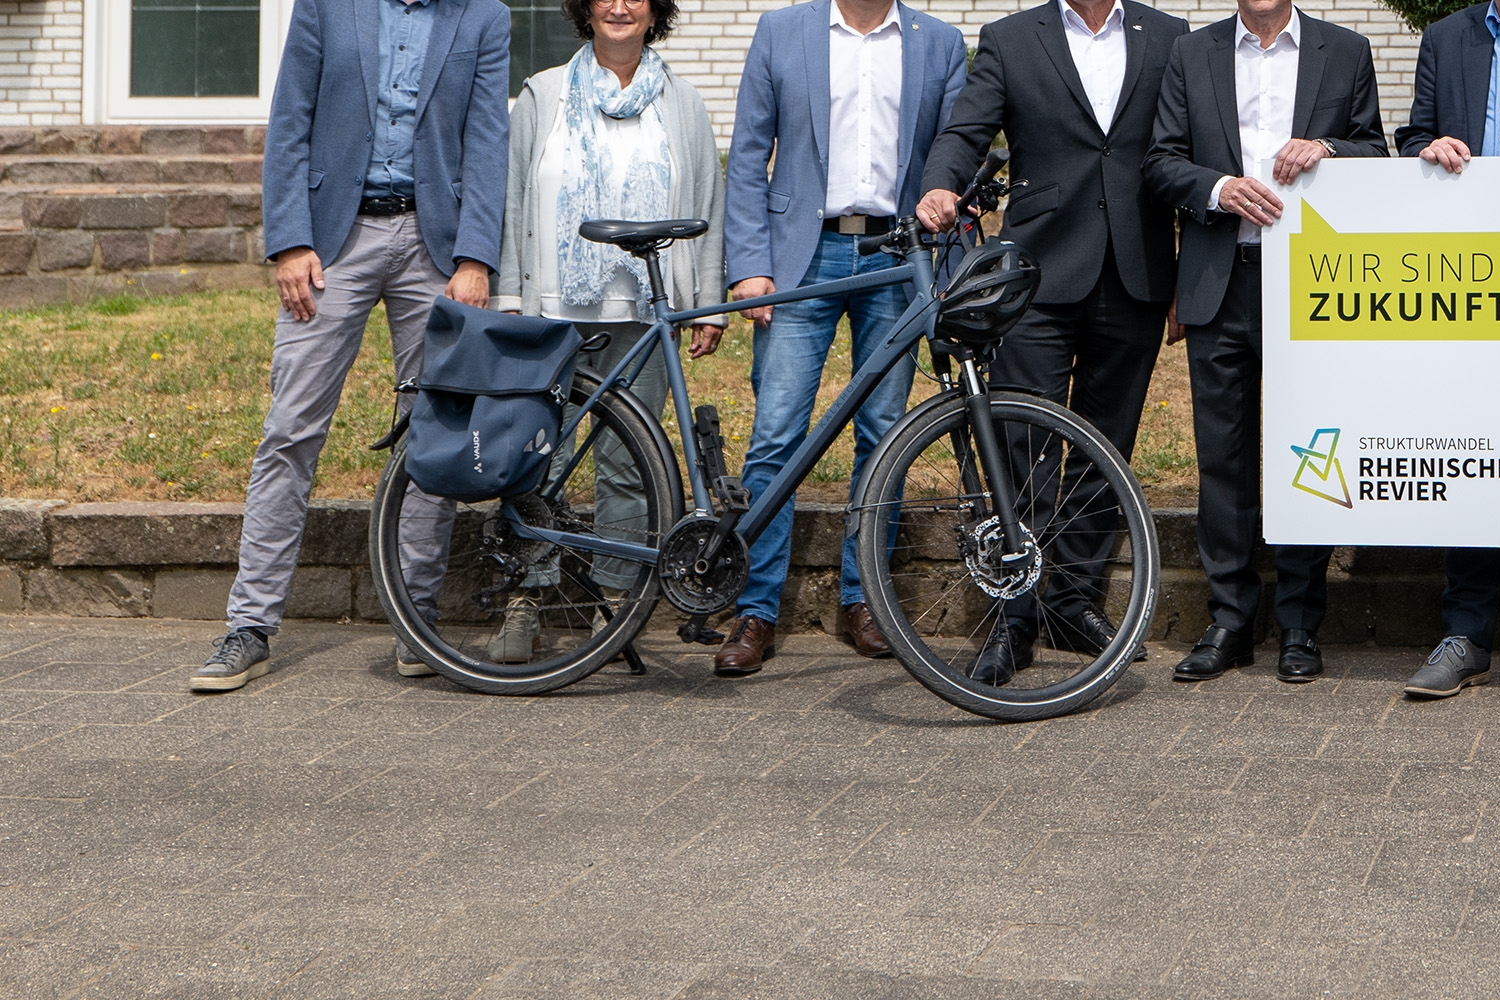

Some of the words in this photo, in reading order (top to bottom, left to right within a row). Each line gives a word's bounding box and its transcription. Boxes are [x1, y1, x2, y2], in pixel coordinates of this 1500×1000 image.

[1309, 253, 1382, 283] WIR
[1401, 252, 1494, 283] SIND
[818, 371, 864, 429] KALKHOFF
[1359, 436, 1495, 451] STRUKTURWANDEL
[1359, 480, 1447, 502] REVIER
